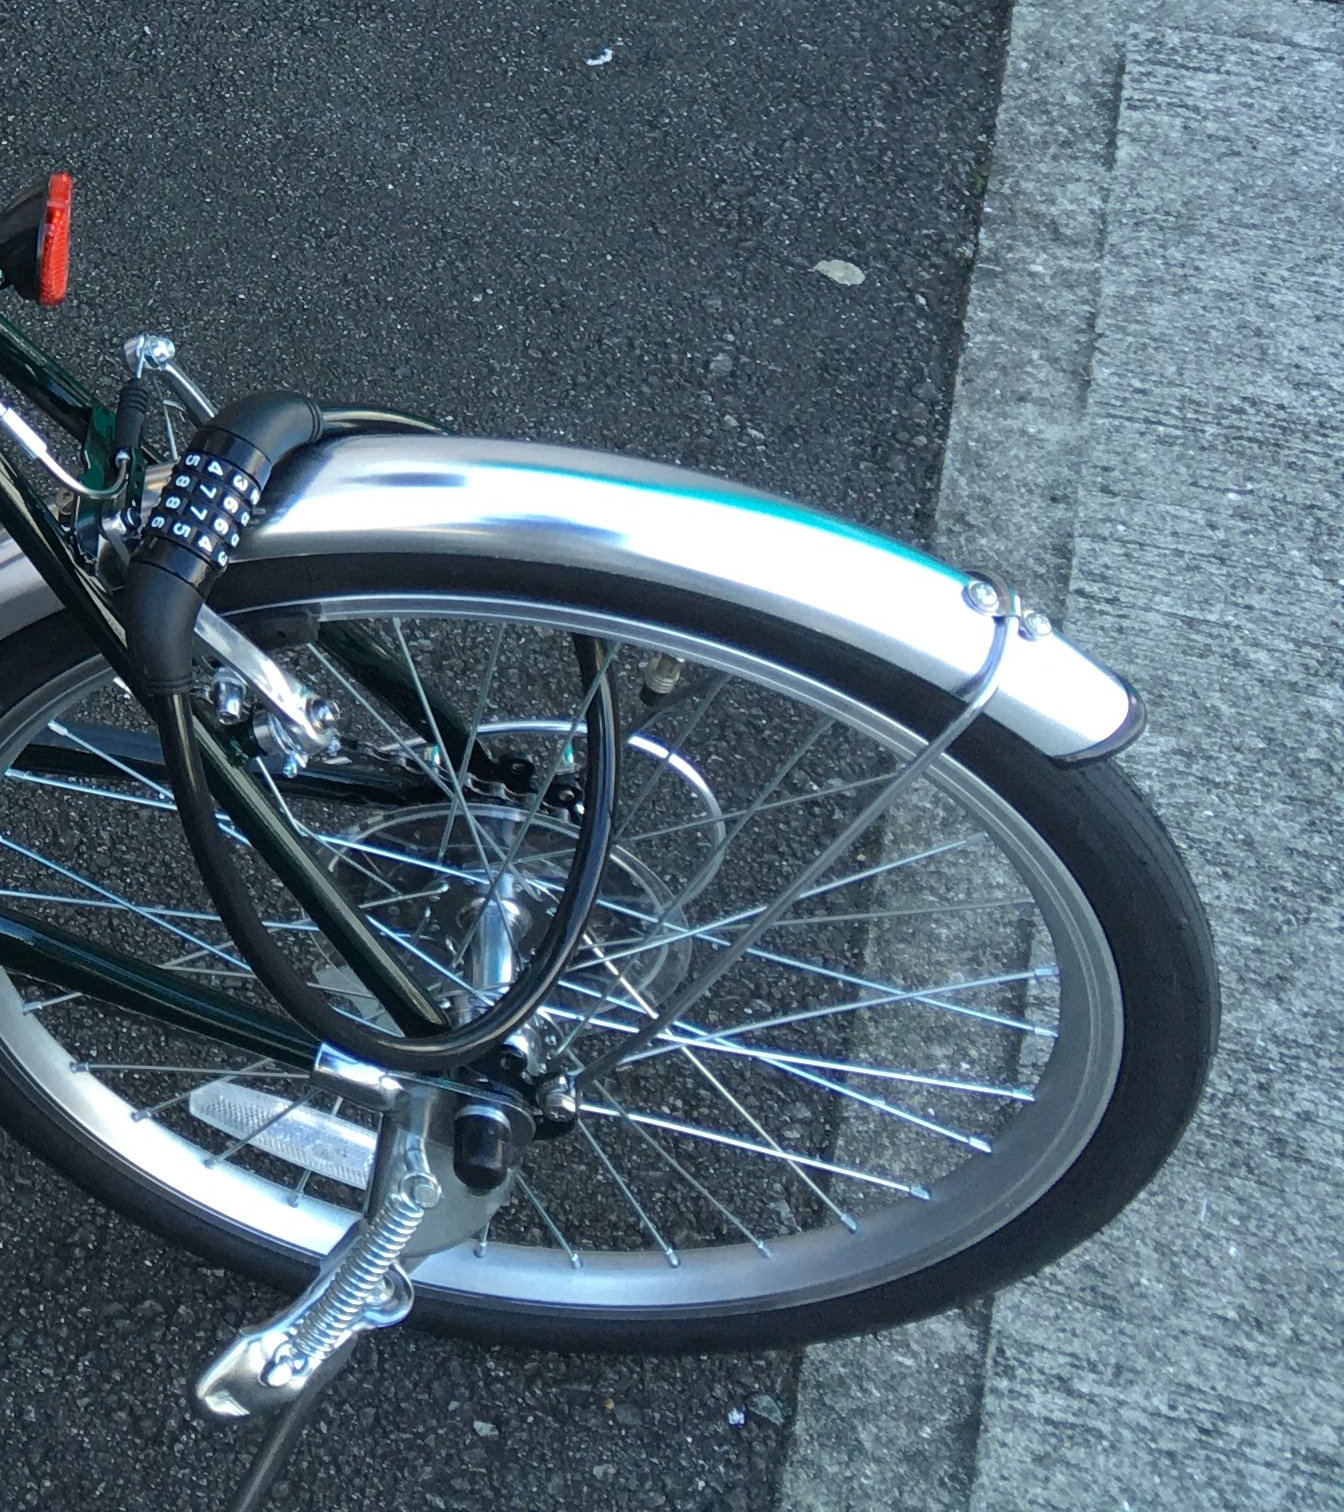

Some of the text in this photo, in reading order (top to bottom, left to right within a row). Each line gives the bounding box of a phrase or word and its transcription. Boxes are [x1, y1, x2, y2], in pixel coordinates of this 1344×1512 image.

[185, 454, 201, 467] 5
[175, 475, 190, 488] 8
[165, 496, 181, 509] 8
[173, 461, 224, 538] 4 7 7 5
[198, 474, 249, 552] 3 6 6 4
